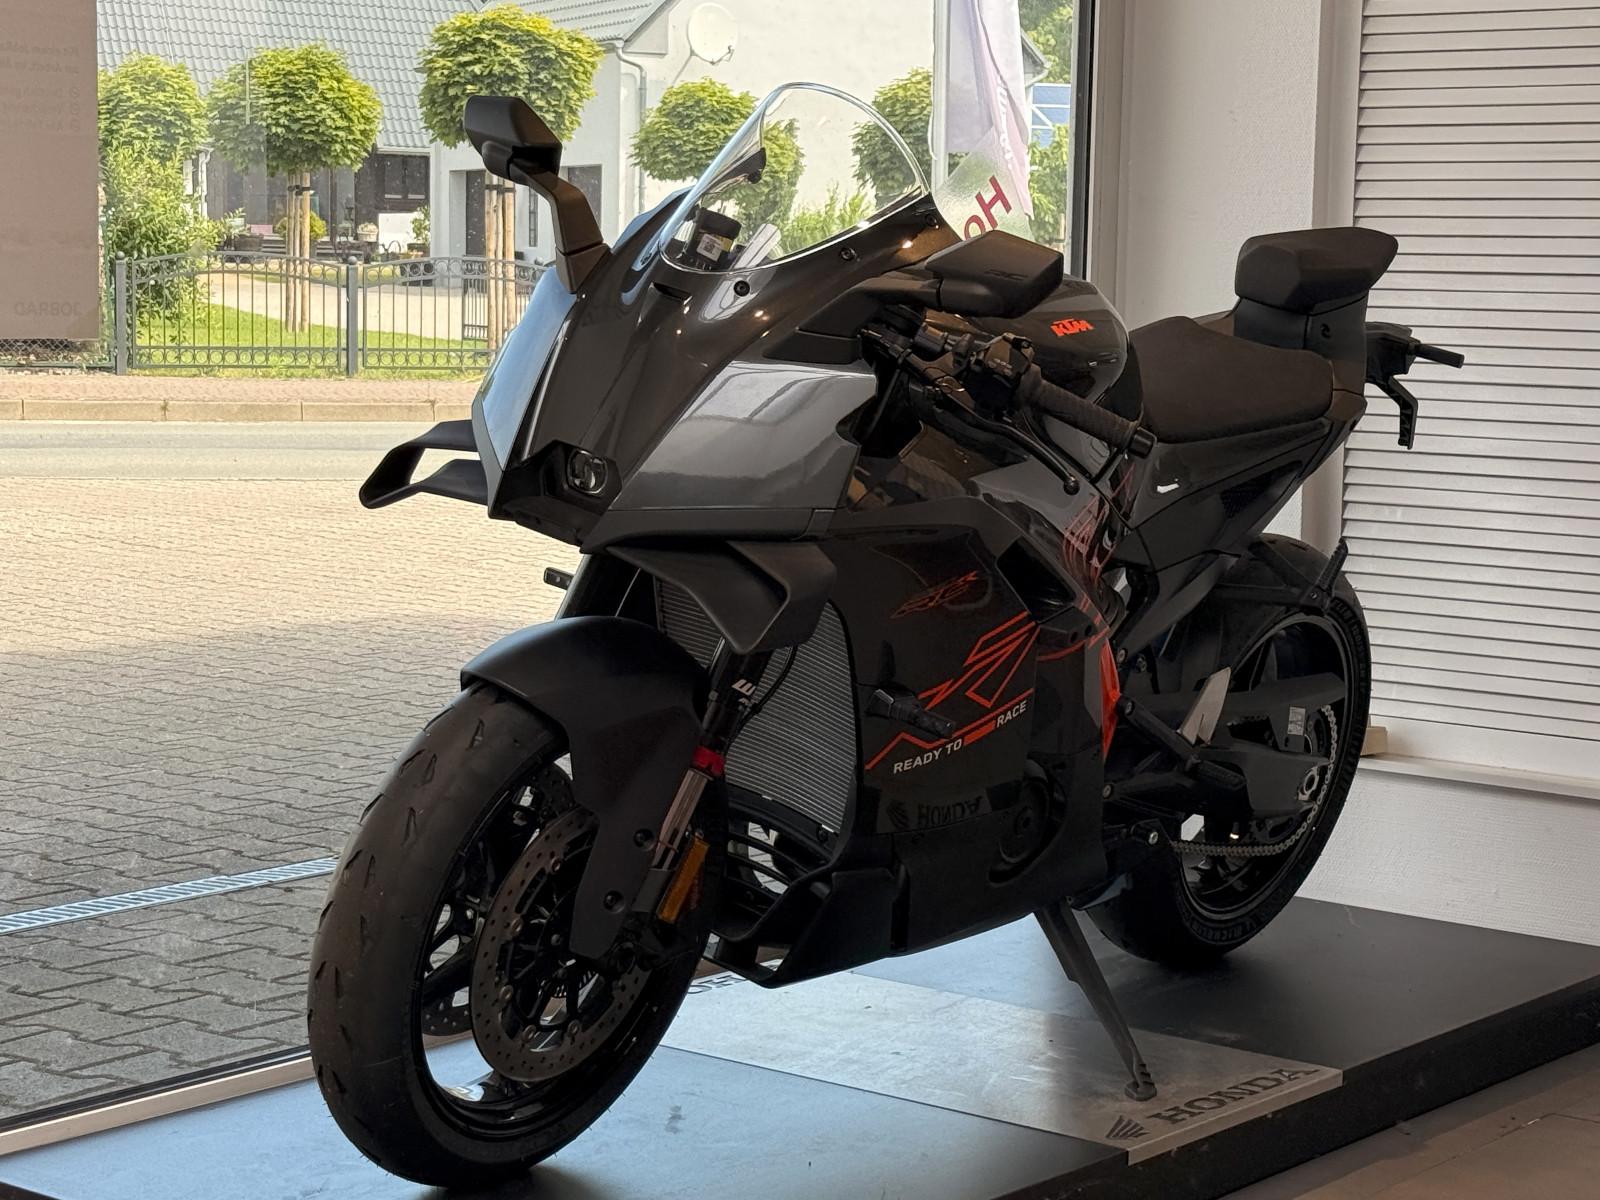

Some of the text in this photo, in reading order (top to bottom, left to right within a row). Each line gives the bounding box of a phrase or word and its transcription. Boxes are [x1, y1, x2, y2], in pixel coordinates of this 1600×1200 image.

[1050, 318, 1094, 337] KTM
[893, 700, 1028, 774] READY TO RACE
[1146, 1068, 1320, 1125] HONDA
